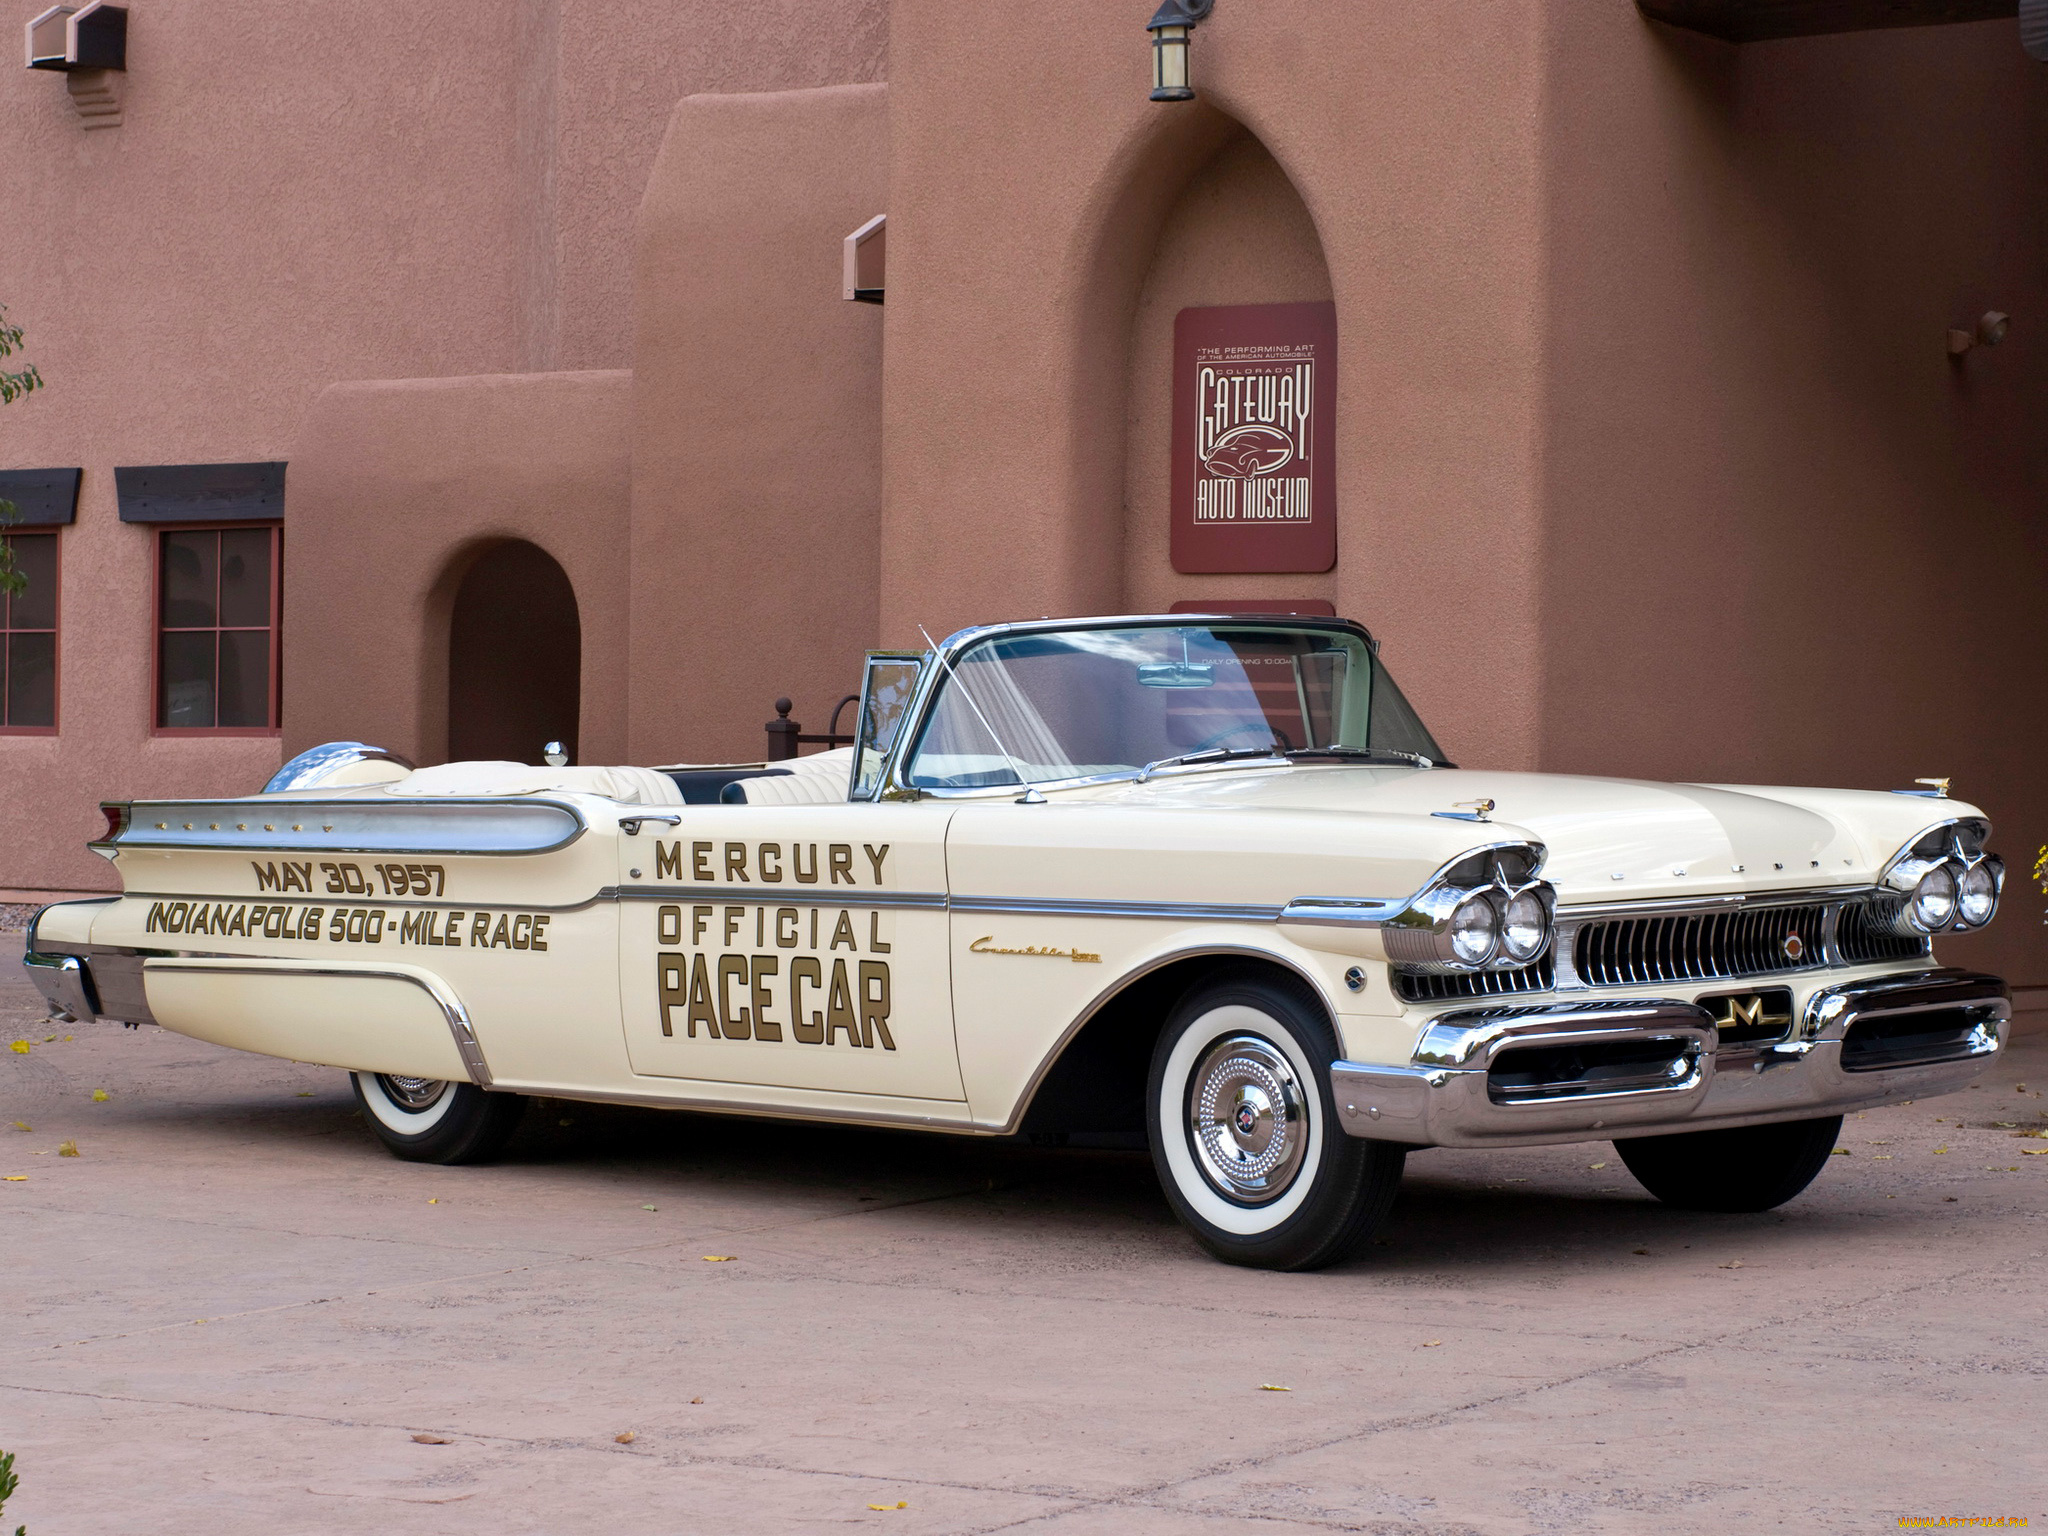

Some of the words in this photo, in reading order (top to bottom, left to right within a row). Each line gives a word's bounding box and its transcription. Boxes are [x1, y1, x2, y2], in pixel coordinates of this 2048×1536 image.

[1216, 367, 1293, 375] COLORADO
[1224, 345, 1290, 354] PERFORMING
[1198, 363, 1311, 462] GATEWAY
[1197, 478, 1236, 519] AUTO
[1242, 477, 1309, 519] MUSEUM
[251, 861, 312, 892] MAY
[656, 840, 890, 885] MERCURY
[146, 902, 324, 940] INDIANAPOLIS
[471, 912, 550, 951] RACE
[658, 904, 891, 954] OFFICIAL
[657, 951, 783, 1042] PACE
[790, 955, 897, 1051] CAR
